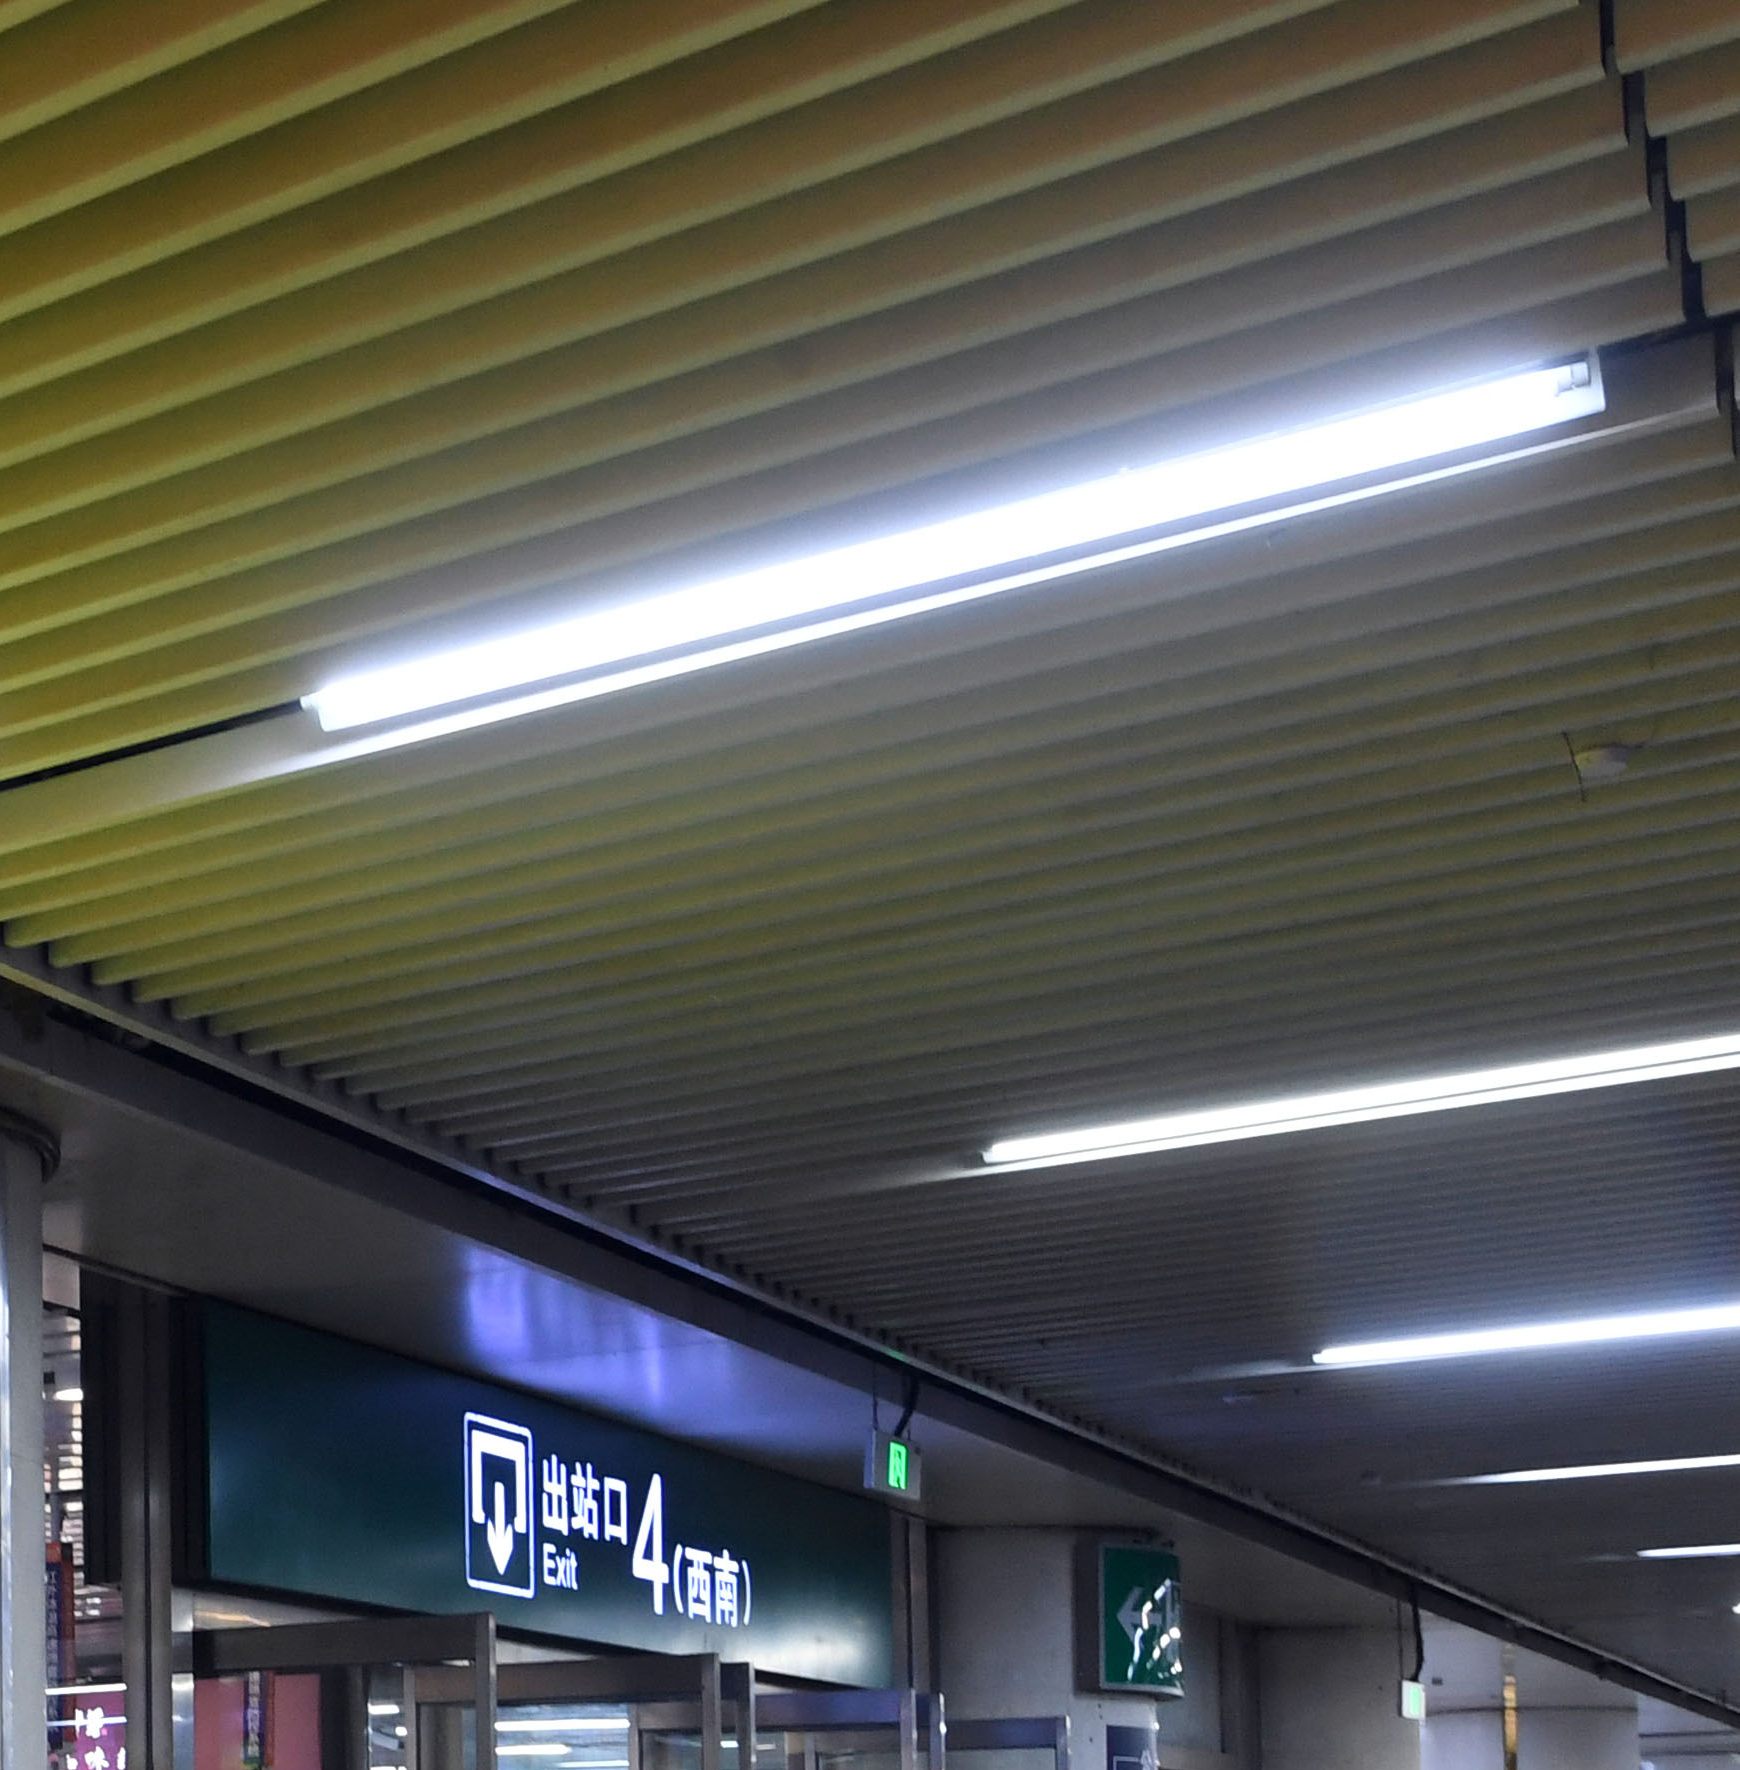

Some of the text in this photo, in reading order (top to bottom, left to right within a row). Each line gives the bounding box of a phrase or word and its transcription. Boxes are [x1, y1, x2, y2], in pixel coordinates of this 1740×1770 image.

[542, 1453, 752, 1628] 出站口 4 (西南)
[542, 1542, 579, 1590] Exit
